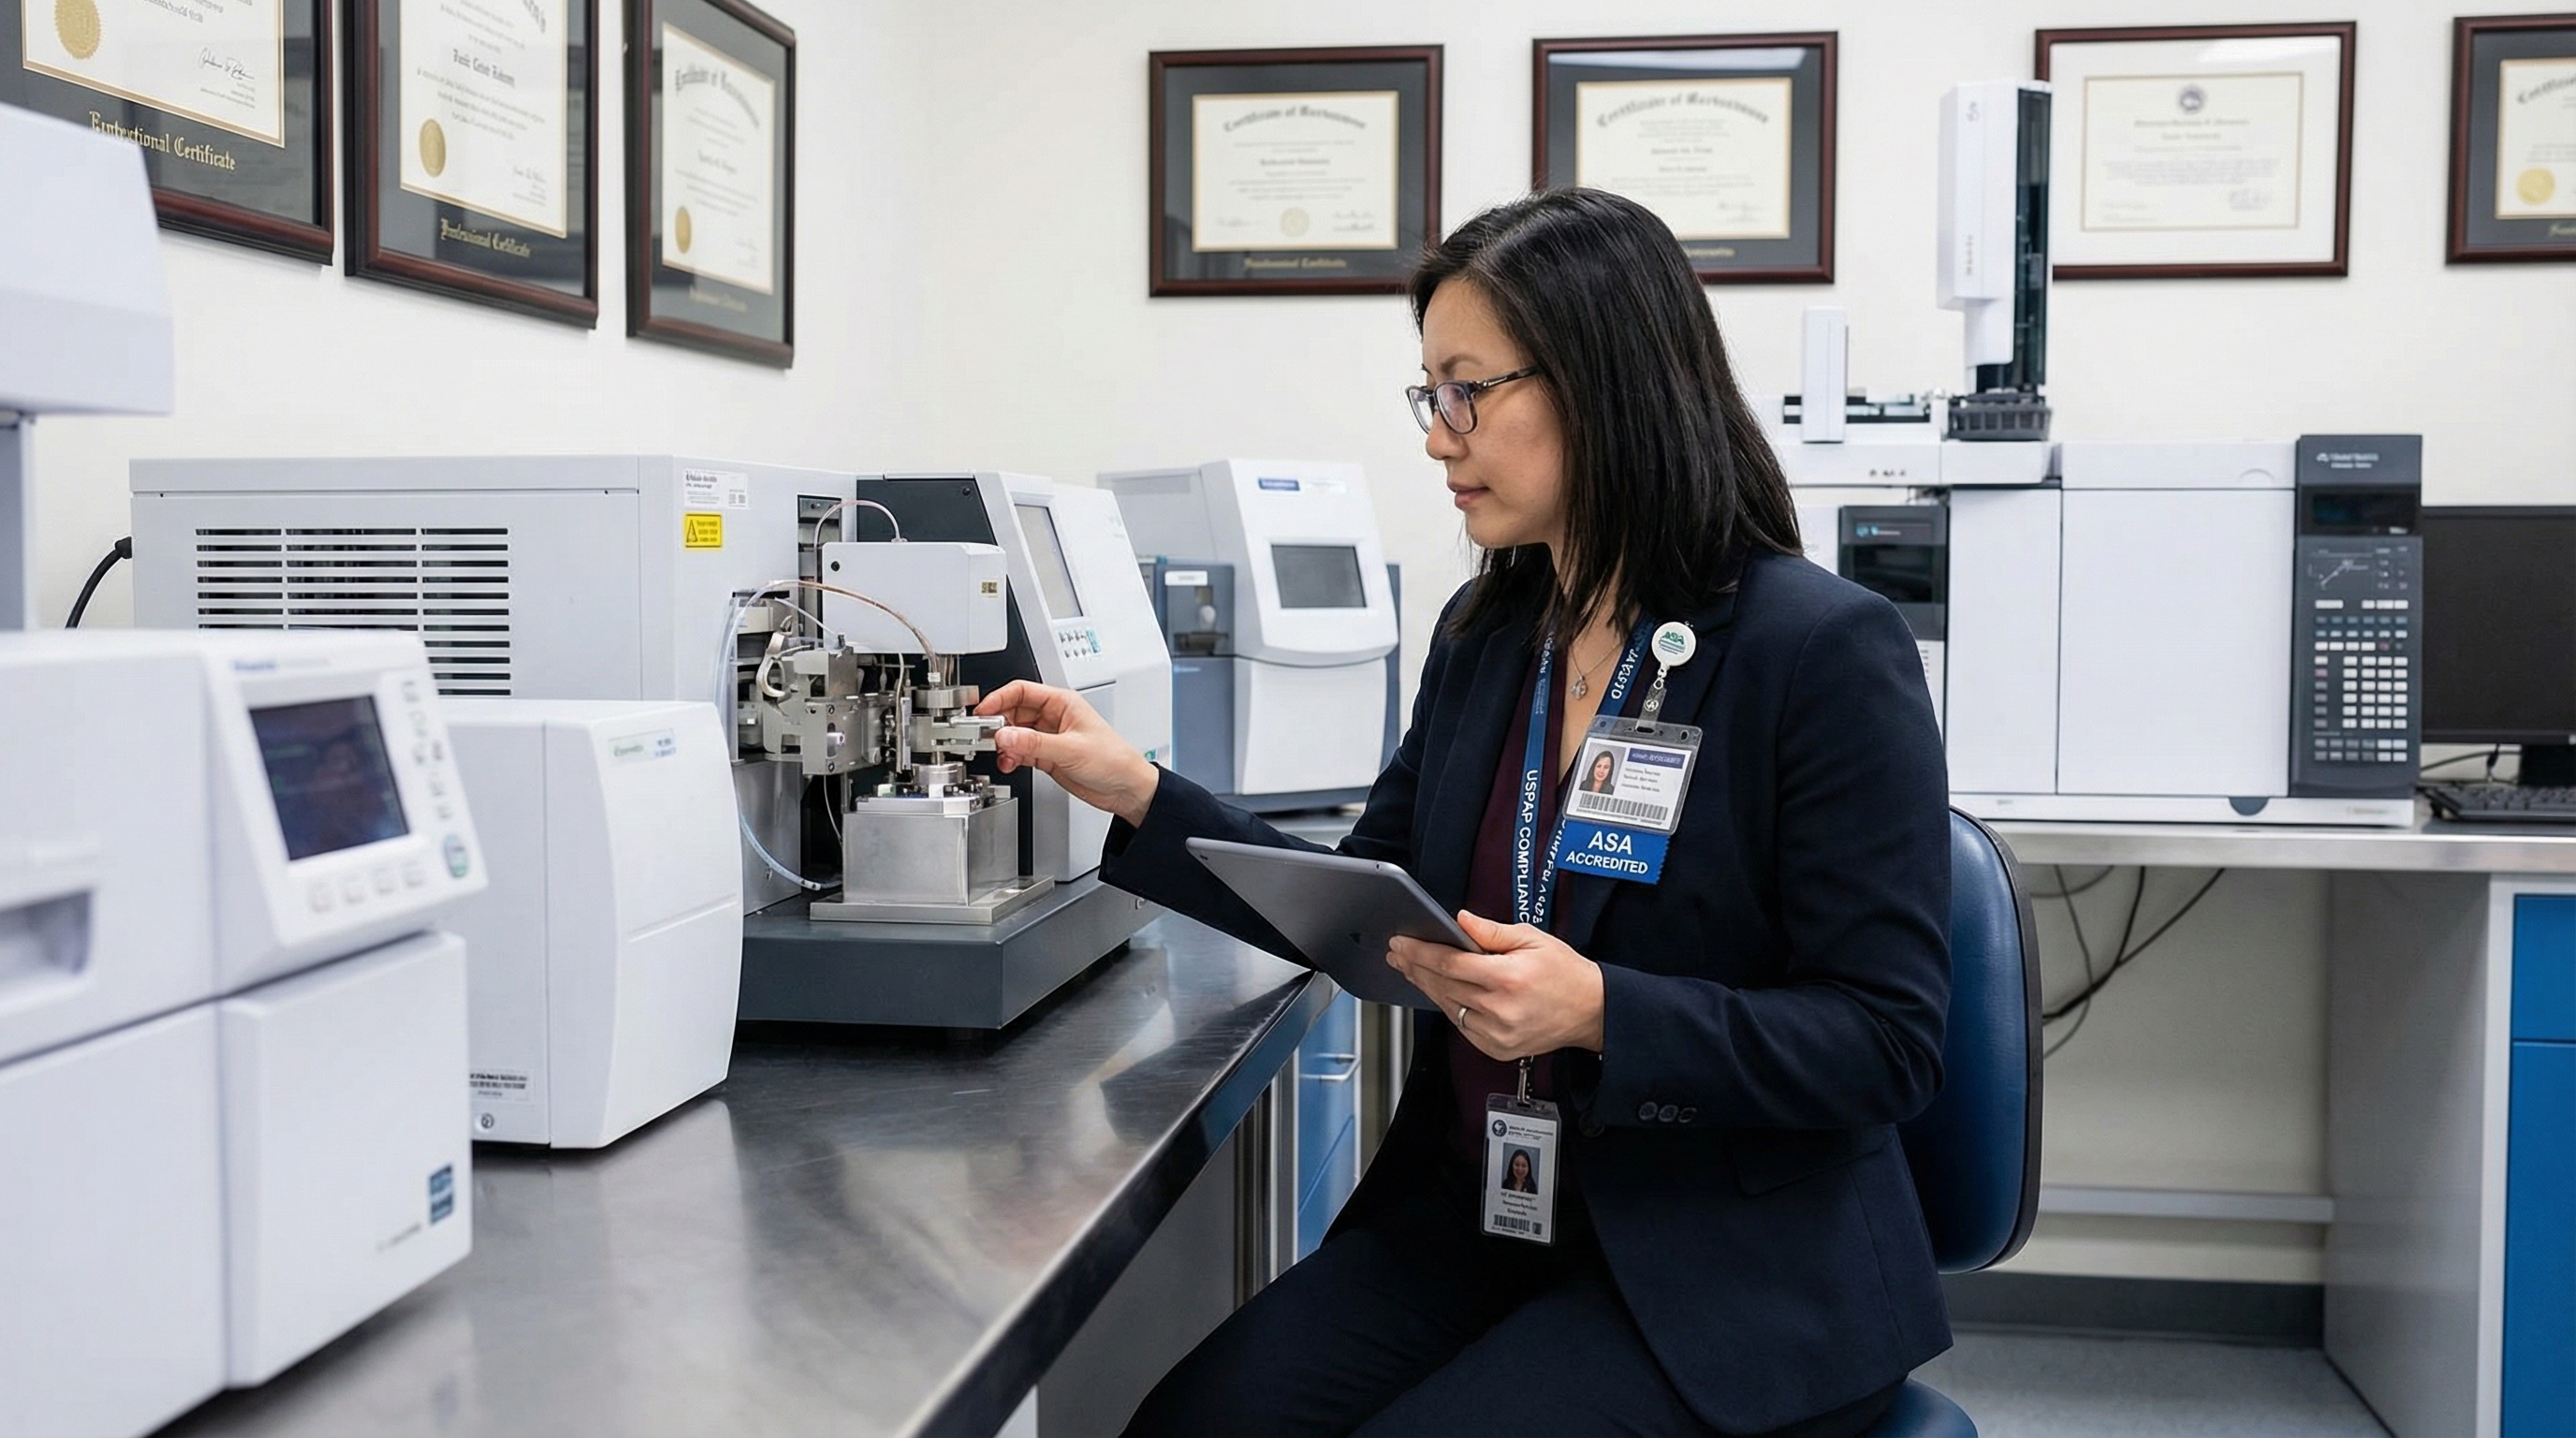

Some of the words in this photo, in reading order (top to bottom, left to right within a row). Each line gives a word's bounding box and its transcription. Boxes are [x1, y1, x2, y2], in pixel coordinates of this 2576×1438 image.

[174, 136, 236, 170] Certificate
[1521, 770, 1538, 824] USPAP
[1588, 830, 1632, 855] ASA
[1516, 827, 1531, 923] COMPLIANC
[1565, 850, 1648, 874] ACCREDITED
